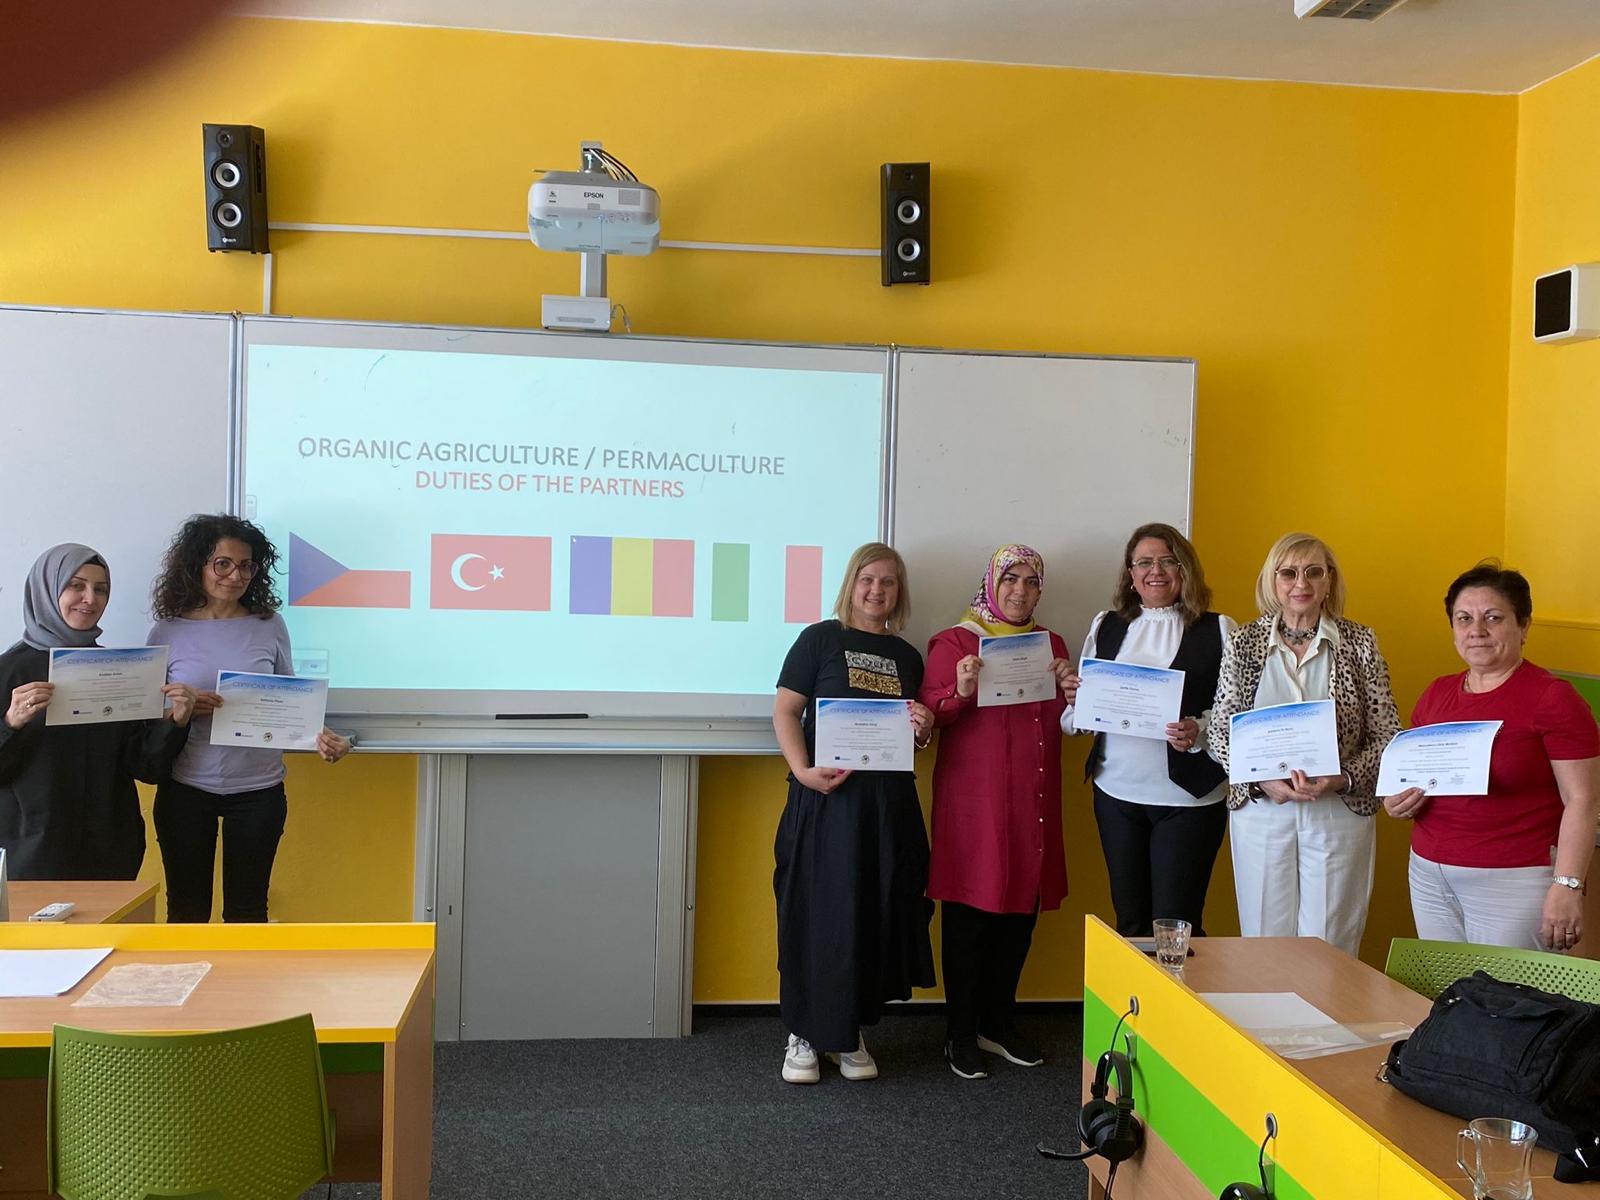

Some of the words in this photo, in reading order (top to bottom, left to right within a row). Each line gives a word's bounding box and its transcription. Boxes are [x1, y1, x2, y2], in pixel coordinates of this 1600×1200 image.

[583, 191, 604, 199] EPSON
[298, 437, 411, 460] ORGANIC
[416, 441, 579, 466] AGRICULTURE
[584, 446, 596, 470] /
[602, 449, 785, 475] PERMACULTURE
[415, 471, 493, 491] DUTIES
[498, 473, 527, 492] OF
[532, 474, 574, 494] THE
[580, 477, 685, 498] PARTNERS
[66, 657, 105, 665] CERTIFICATE
[115, 656, 153, 664] ATTENDANCE
[1093, 668, 1125, 678] CERTIFICATE
[1134, 673, 1170, 684] ATTENDANCE
[232, 681, 266, 690] CERTIFICATE
[277, 685, 313, 693] ATTENDANCE
[1283, 710, 1320, 719] ATTENDANCE
